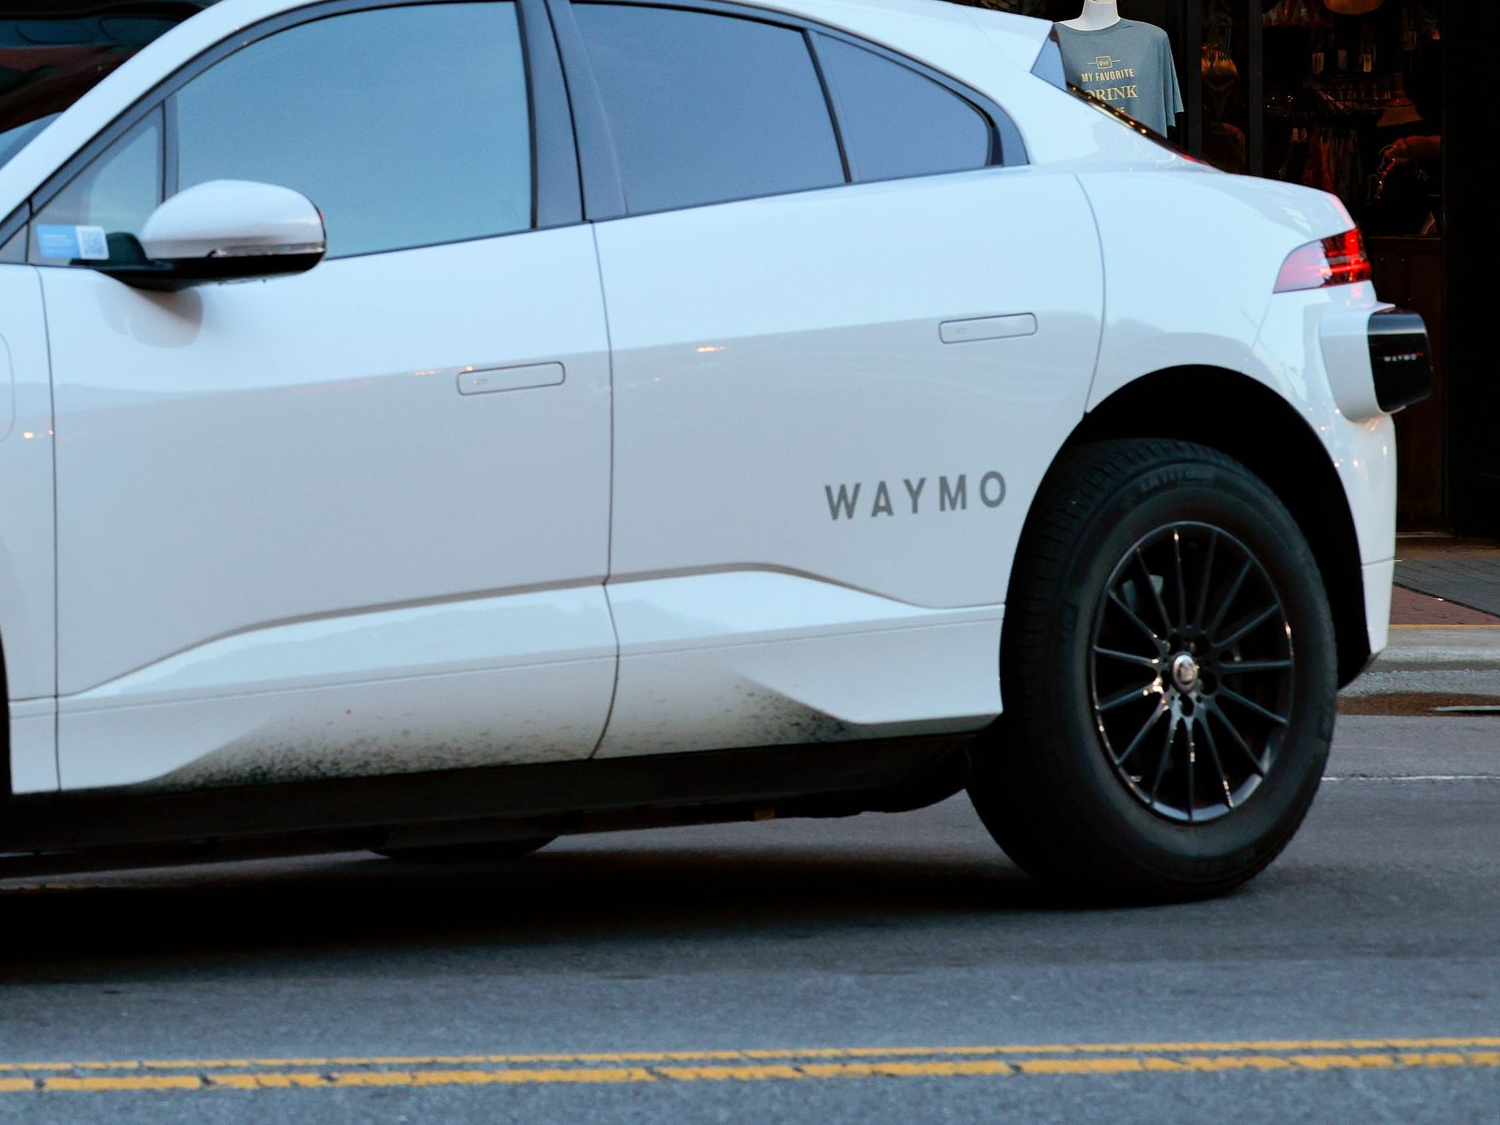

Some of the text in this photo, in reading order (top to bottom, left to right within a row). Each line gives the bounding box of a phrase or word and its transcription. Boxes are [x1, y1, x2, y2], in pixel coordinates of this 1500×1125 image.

[1081, 68, 1135, 83] MY FAVORITE
[1384, 353, 1418, 362] WAYMO
[825, 470, 1007, 521] WAYMO
